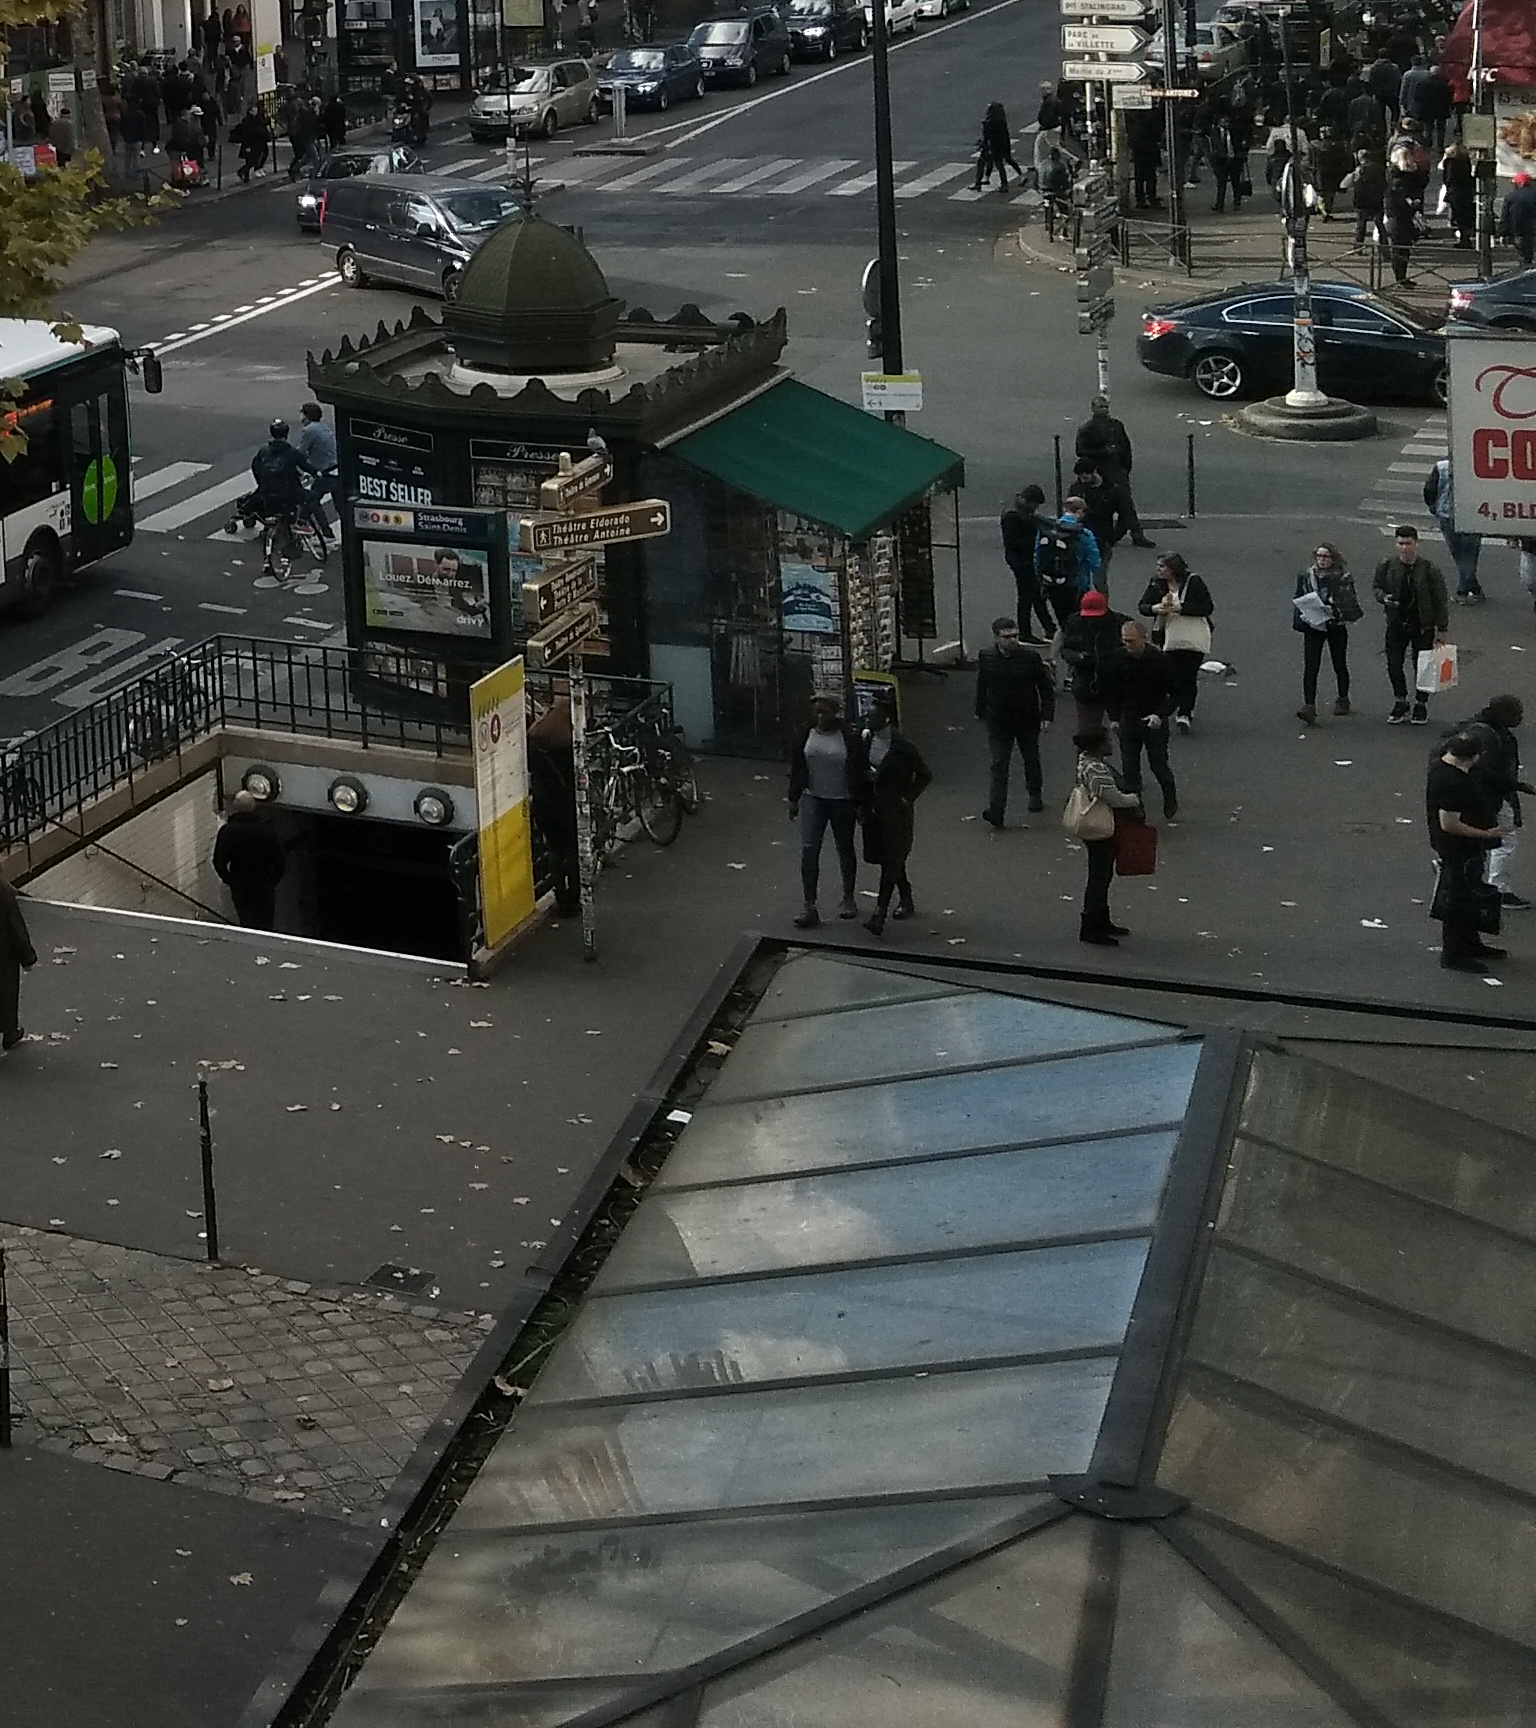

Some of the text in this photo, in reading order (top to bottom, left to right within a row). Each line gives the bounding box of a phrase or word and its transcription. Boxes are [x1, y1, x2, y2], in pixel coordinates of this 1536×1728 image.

[1080, 2, 1126, 11] STALINGRAD
[1067, 30, 1088, 38] PARC
[1077, 40, 1115, 49] VILLETTE
[359, 474, 432, 506] BEST SELLER
[417, 512, 464, 527] Strasbourg
[589, 514, 630, 529] Eldorado
[593, 526, 631, 540] Antoine
[379, 572, 415, 585] Louez.
[457, 614, 485, 627] drivy
